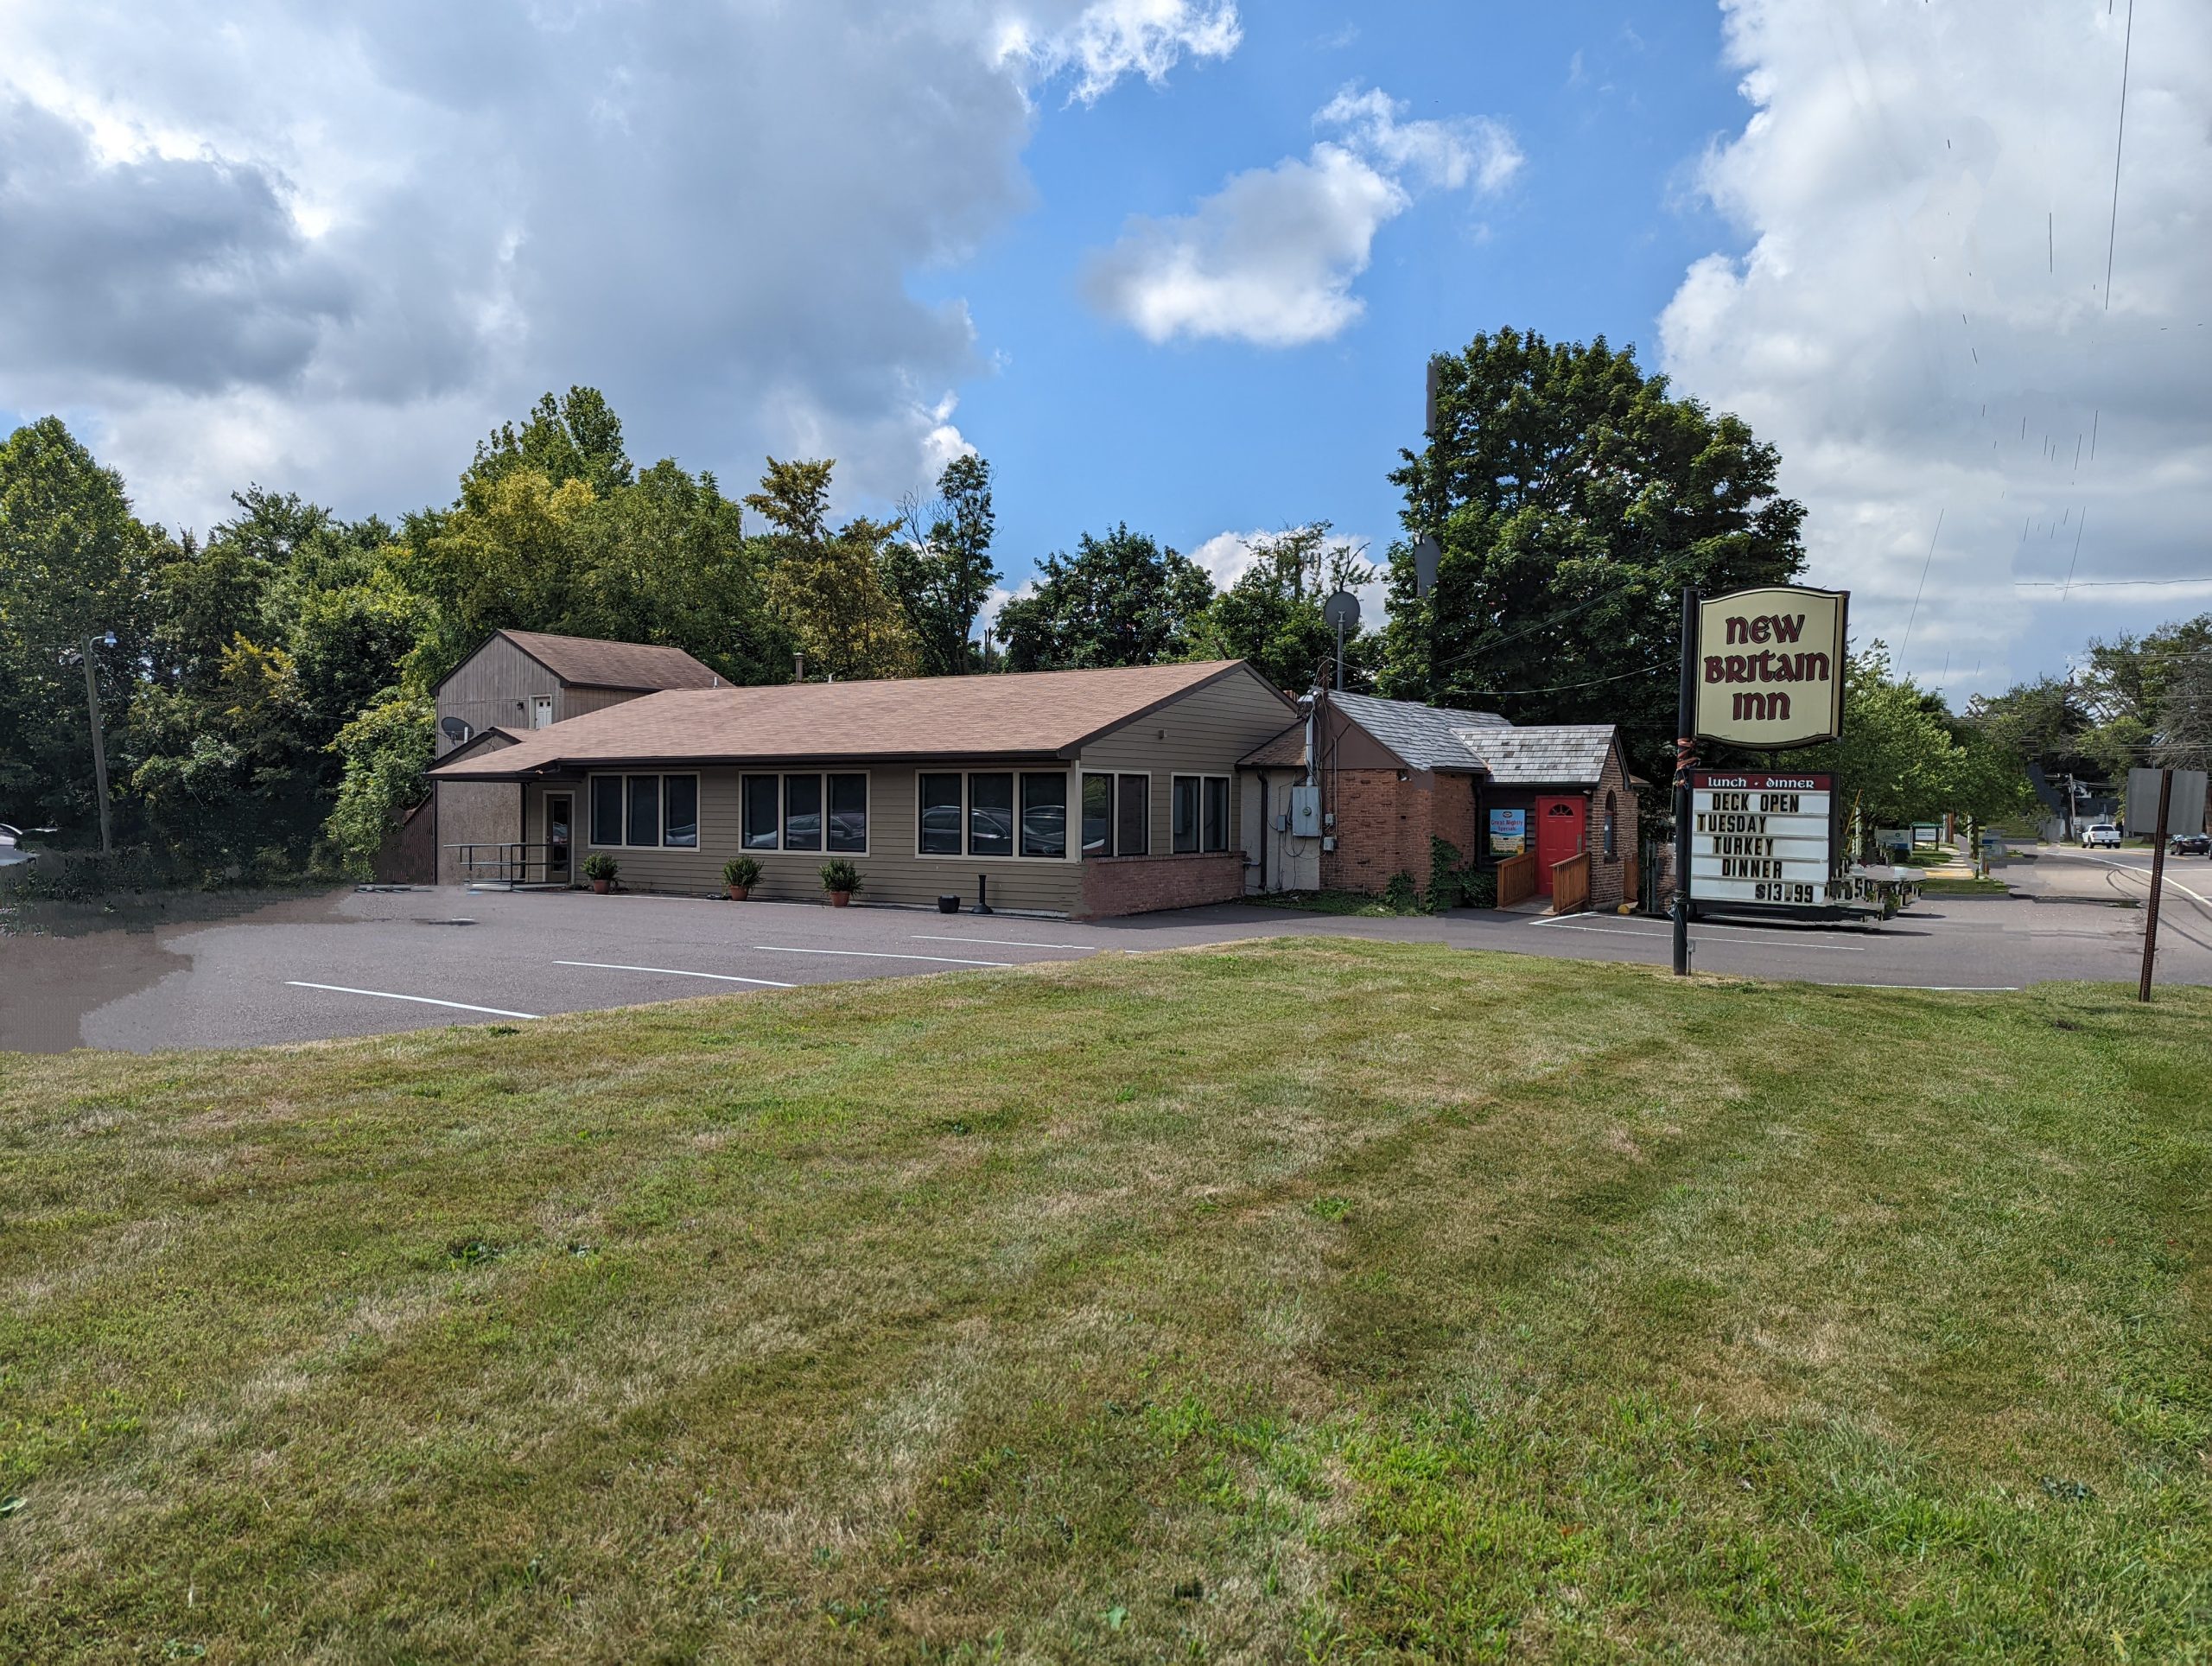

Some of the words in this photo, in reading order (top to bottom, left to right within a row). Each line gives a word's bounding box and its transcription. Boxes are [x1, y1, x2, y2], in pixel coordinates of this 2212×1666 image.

[1713, 793, 1749, 811] DECK
[1760, 794, 1799, 813] OPEN
[1698, 814, 1766, 834] TUESDAY
[1713, 836, 1774, 856] TURKEY
[1722, 859, 1783, 880] DINNER
